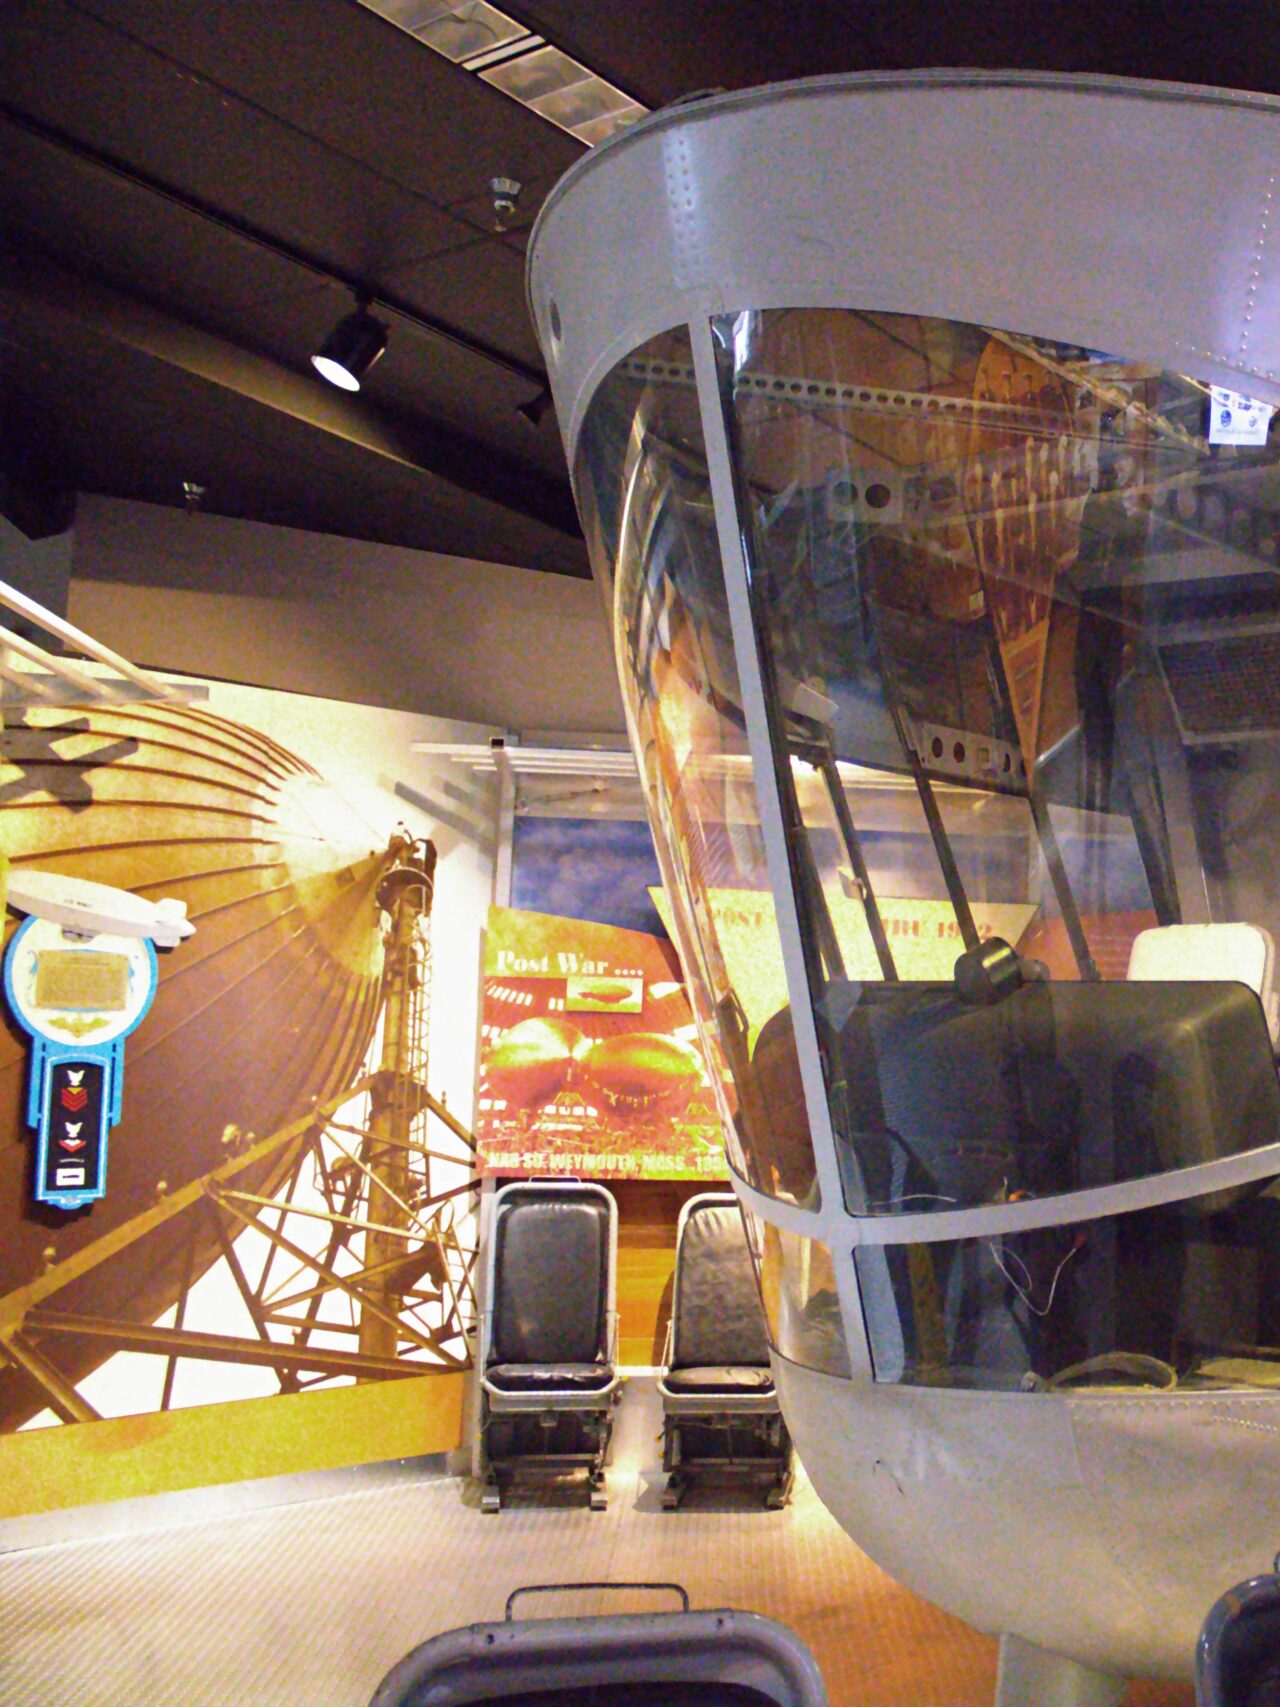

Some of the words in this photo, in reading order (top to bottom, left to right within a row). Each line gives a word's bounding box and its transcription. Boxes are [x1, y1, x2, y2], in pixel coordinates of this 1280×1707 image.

[714, 907, 763, 927] OST
[937, 921, 993, 940] 192
[496, 950, 548, 973] Post
[557, 952, 609, 974] War
